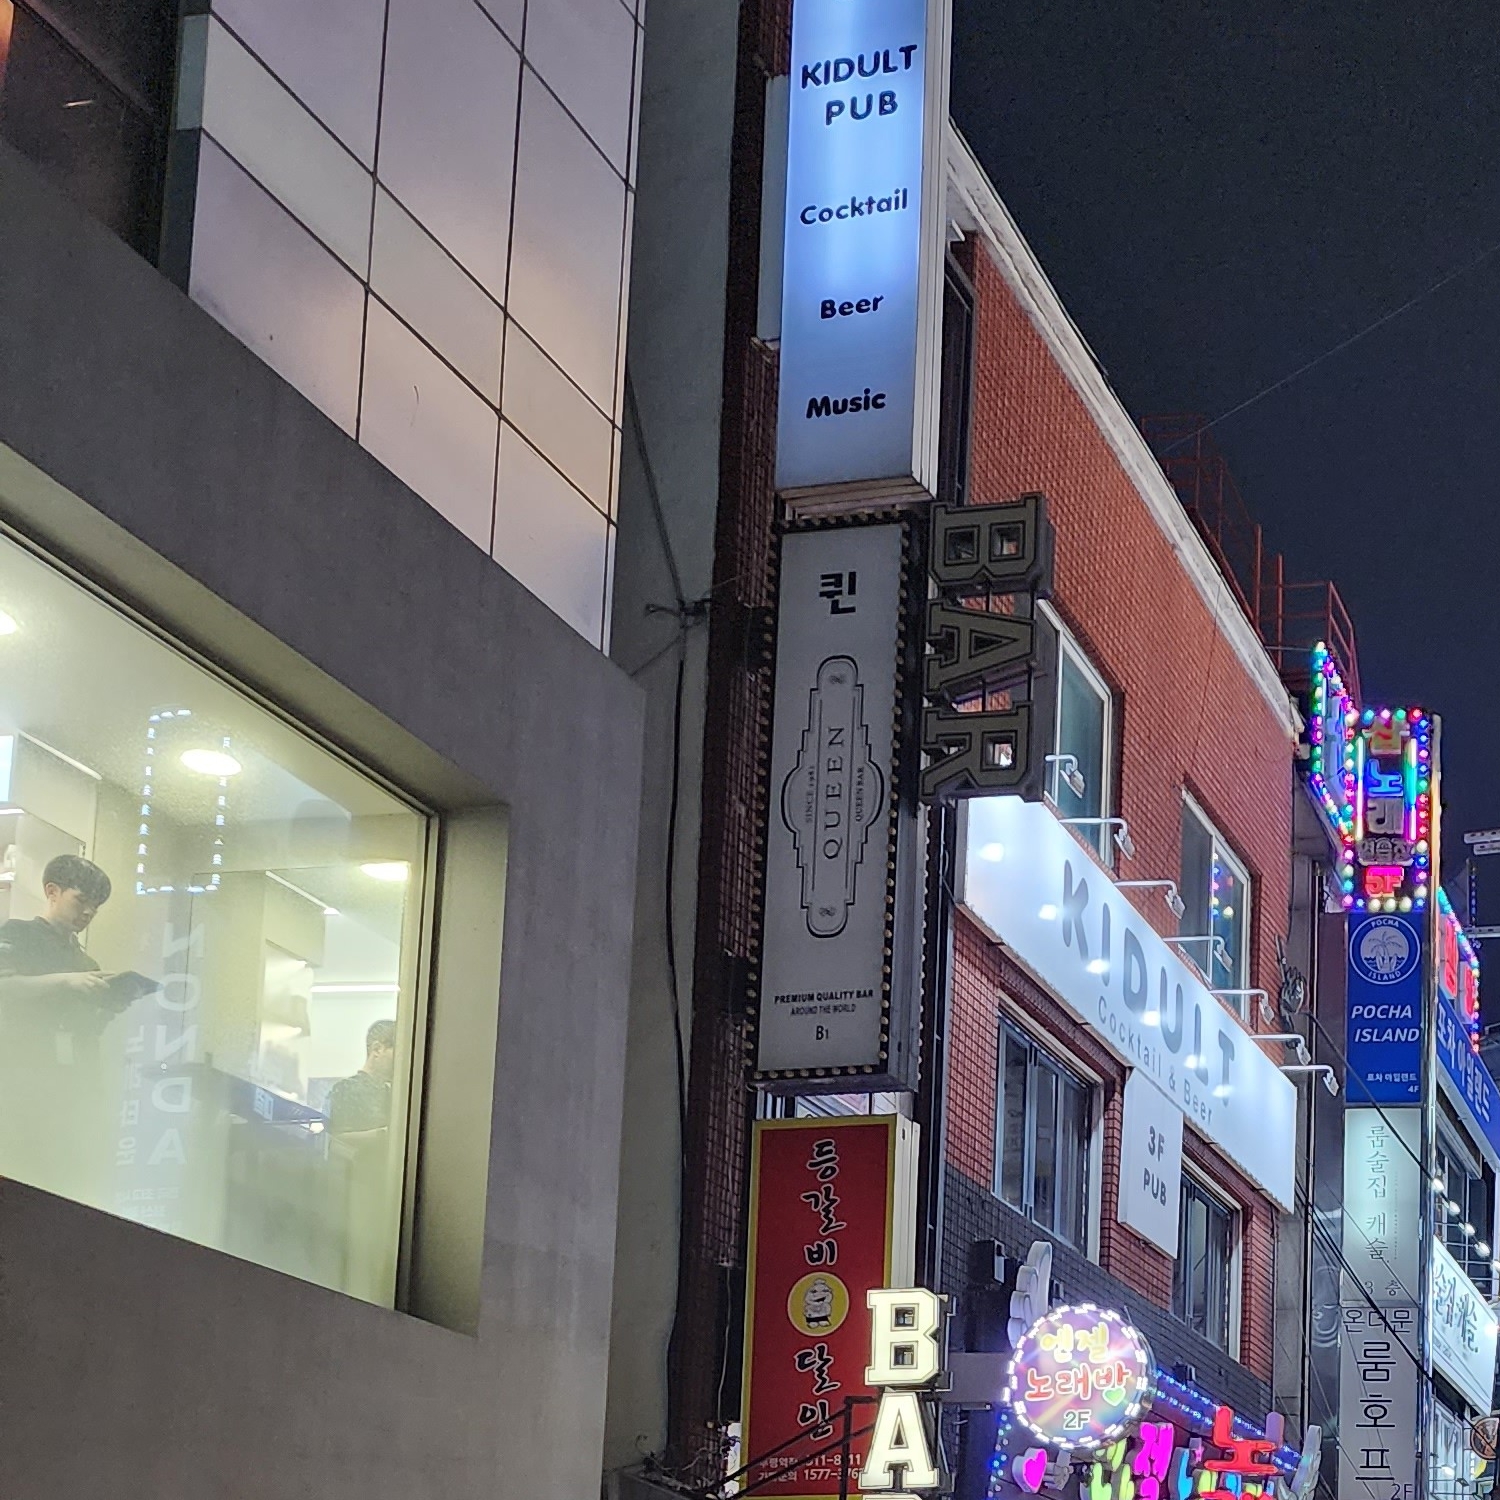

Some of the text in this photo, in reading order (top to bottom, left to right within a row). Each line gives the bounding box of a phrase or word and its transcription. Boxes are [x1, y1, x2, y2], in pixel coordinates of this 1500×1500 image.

[801, 44, 918, 90] KIDULT
[825, 90, 899, 126] PUB
[800, 188, 909, 226] Cocktail
[820, 295, 885, 321] Beer
[806, 388, 887, 420] Music
[818, 570, 858, 615] 퀸
[921, 493, 1054, 802] BAR
[822, 725, 846, 860] QUEEN
[1370, 916, 1400, 929] POCHA
[1063, 859, 1237, 1108] KIDULT
[1367, 970, 1404, 983] ISLAND
[775, 987, 875, 1005] PREMIUM QUALITY BAR
[1351, 1004, 1413, 1020] POCHA
[815, 1025, 830, 1041] B1
[1354, 1027, 1421, 1043] ISLAND
[1098, 994, 1164, 1080] Cocktail
[1183, 1082, 1214, 1125] Beer
[1407, 1084, 1420, 1095] 4F
[1147, 1124, 1166, 1162] 3F
[1365, 1125, 1390, 1199] 룸술집
[800, 1138, 847, 1267] 등갈비
[1142, 1168, 1168, 1208] PUB
[1040, 1322, 1111, 1366] 엔젤
[795, 1343, 841, 1442] 달인
[1354, 1341, 1398, 1482] 룸호프
[1063, 1410, 1092, 1431] 2F
[1389, 1483, 1415, 1500] 2F
